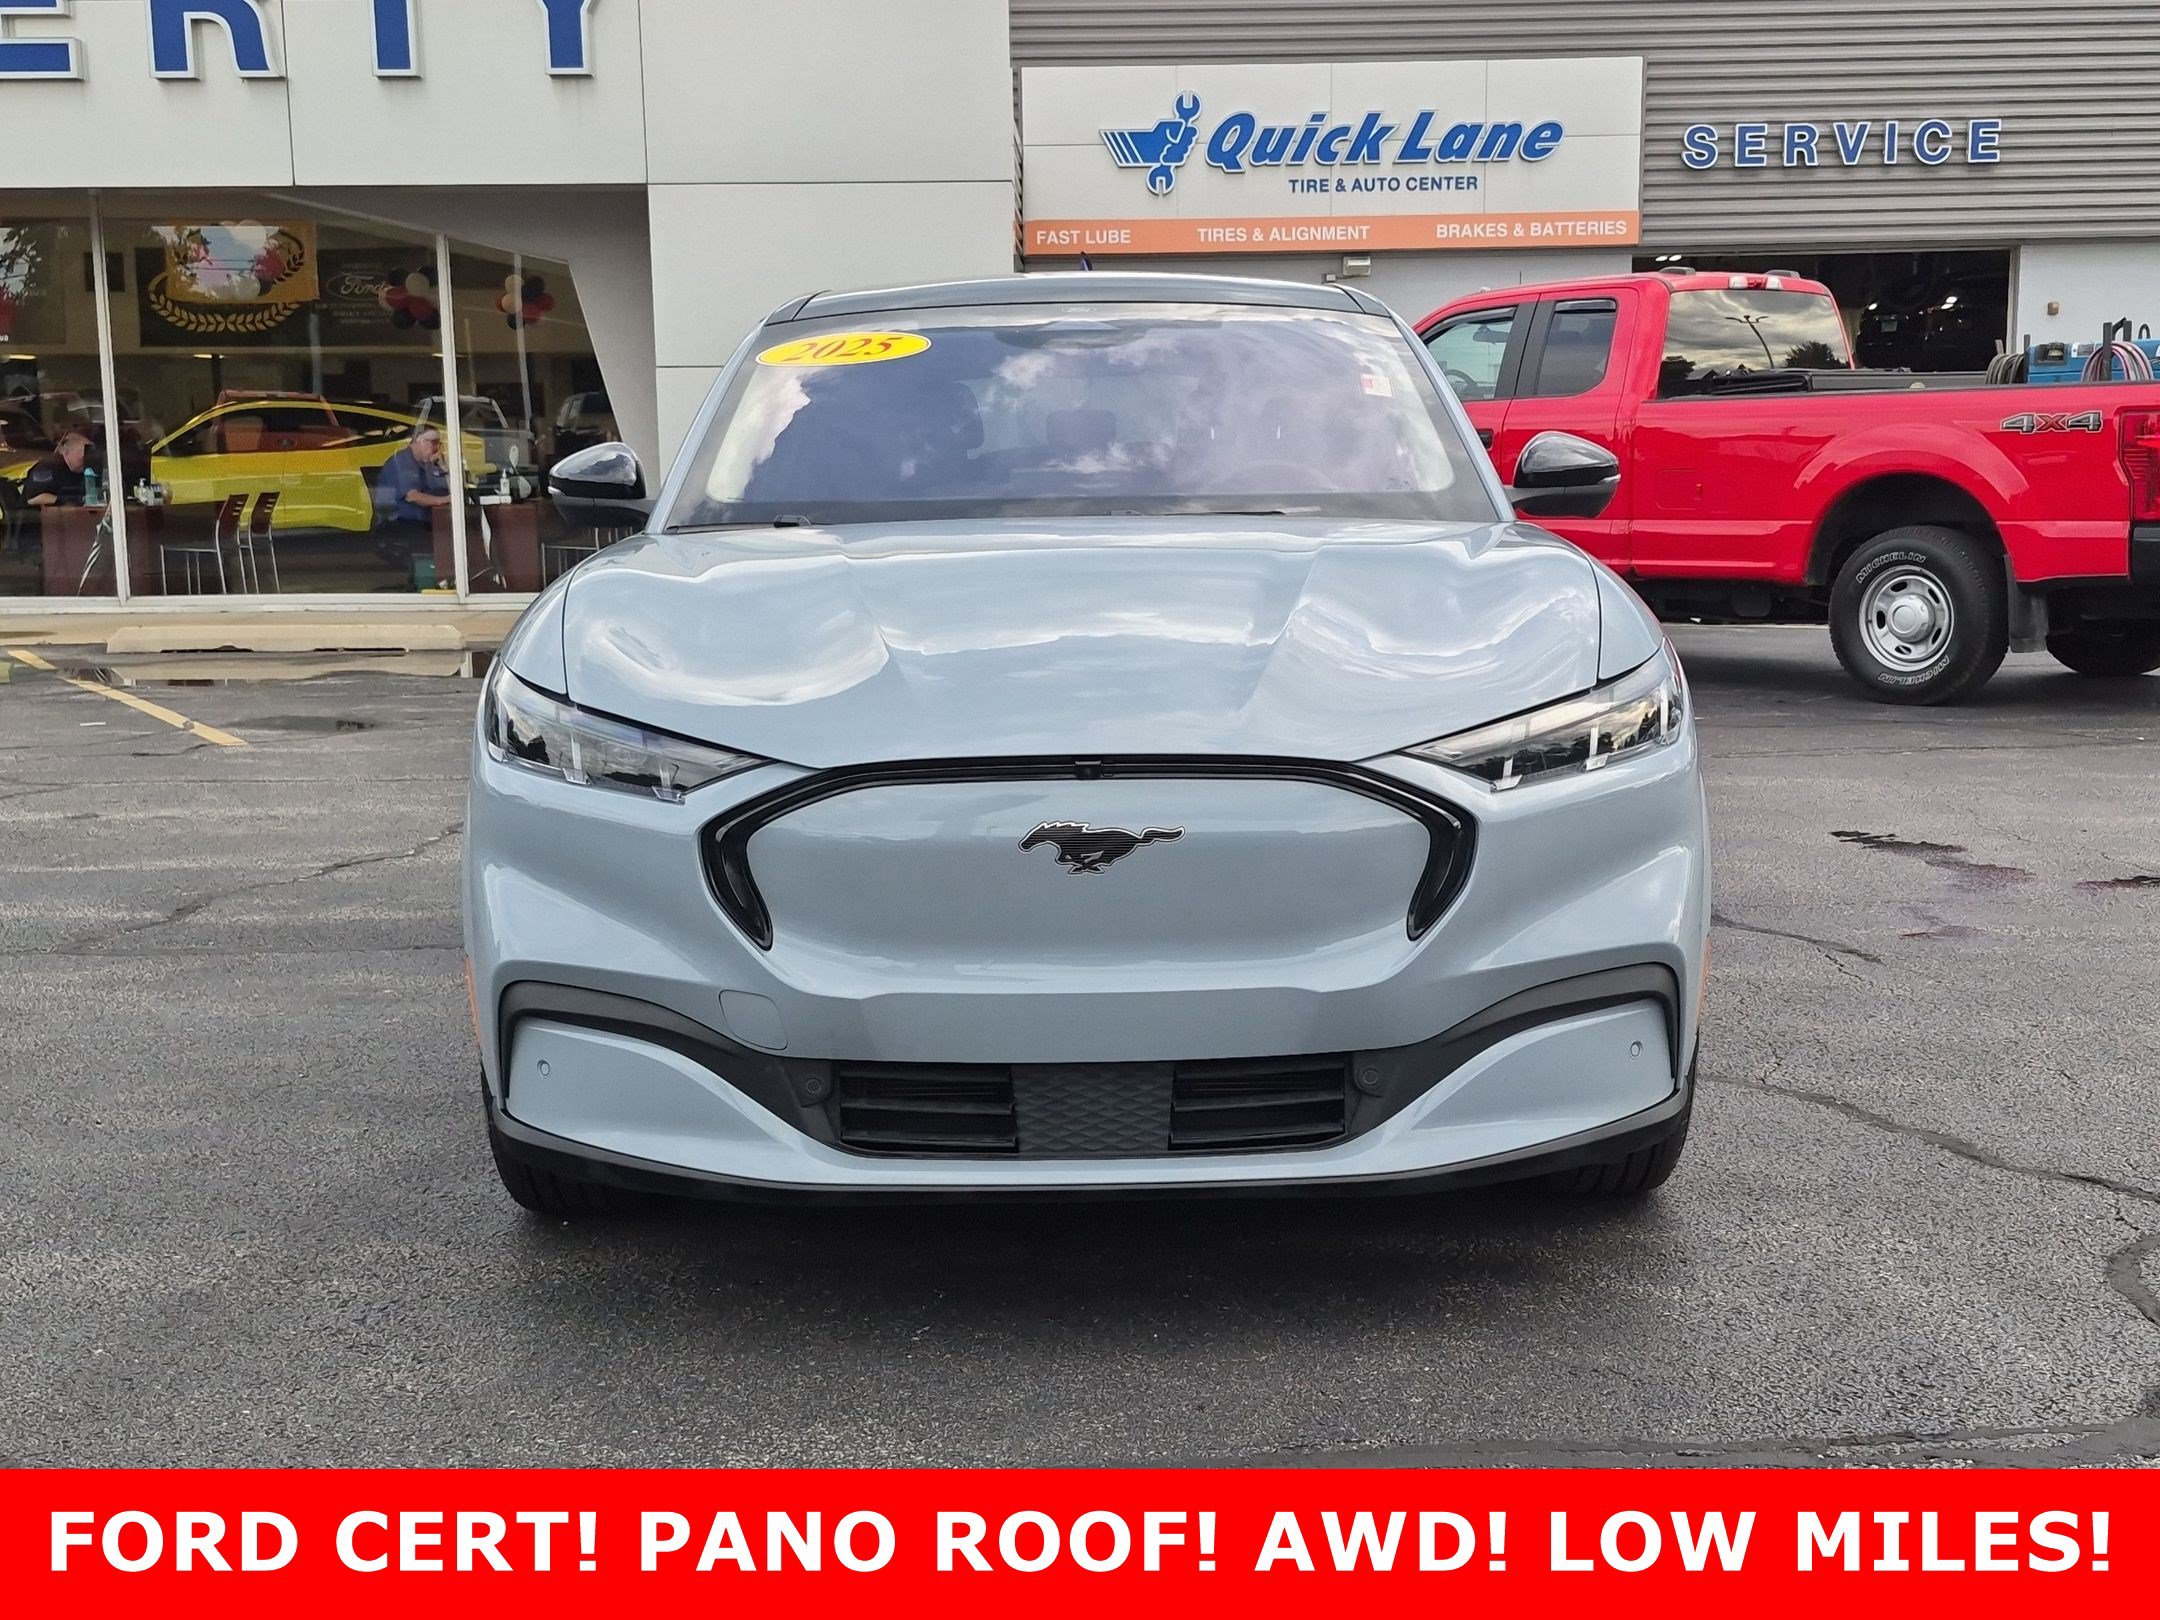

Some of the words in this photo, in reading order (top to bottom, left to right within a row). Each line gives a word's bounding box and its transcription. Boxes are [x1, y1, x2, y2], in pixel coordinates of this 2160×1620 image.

[1205, 110, 1397, 173] Quick
[1393, 108, 1565, 164] Lane
[1682, 118, 2001, 169] SERVICE
[1288, 178, 1329, 193] TIRE
[1335, 178, 1346, 192] &
[1351, 177, 1400, 192] AUTO
[1406, 176, 1478, 191] CENTER
[1036, 230, 1080, 245] FAST
[1085, 229, 1131, 244] LUBE
[1197, 228, 1247, 242] TIRES
[1252, 227, 1264, 241] &
[1269, 225, 1370, 241] ALIGNMENT
[1436, 223, 1508, 238] BRAKES
[1513, 223, 1524, 237] &
[1530, 220, 1627, 236] BATTERIES
[340, 274, 388, 295] Ford
[781, 336, 903, 362] 2025
[1856, 551, 1926, 584] MICHELIN
[1878, 655, 1950, 685] MICHELIN
